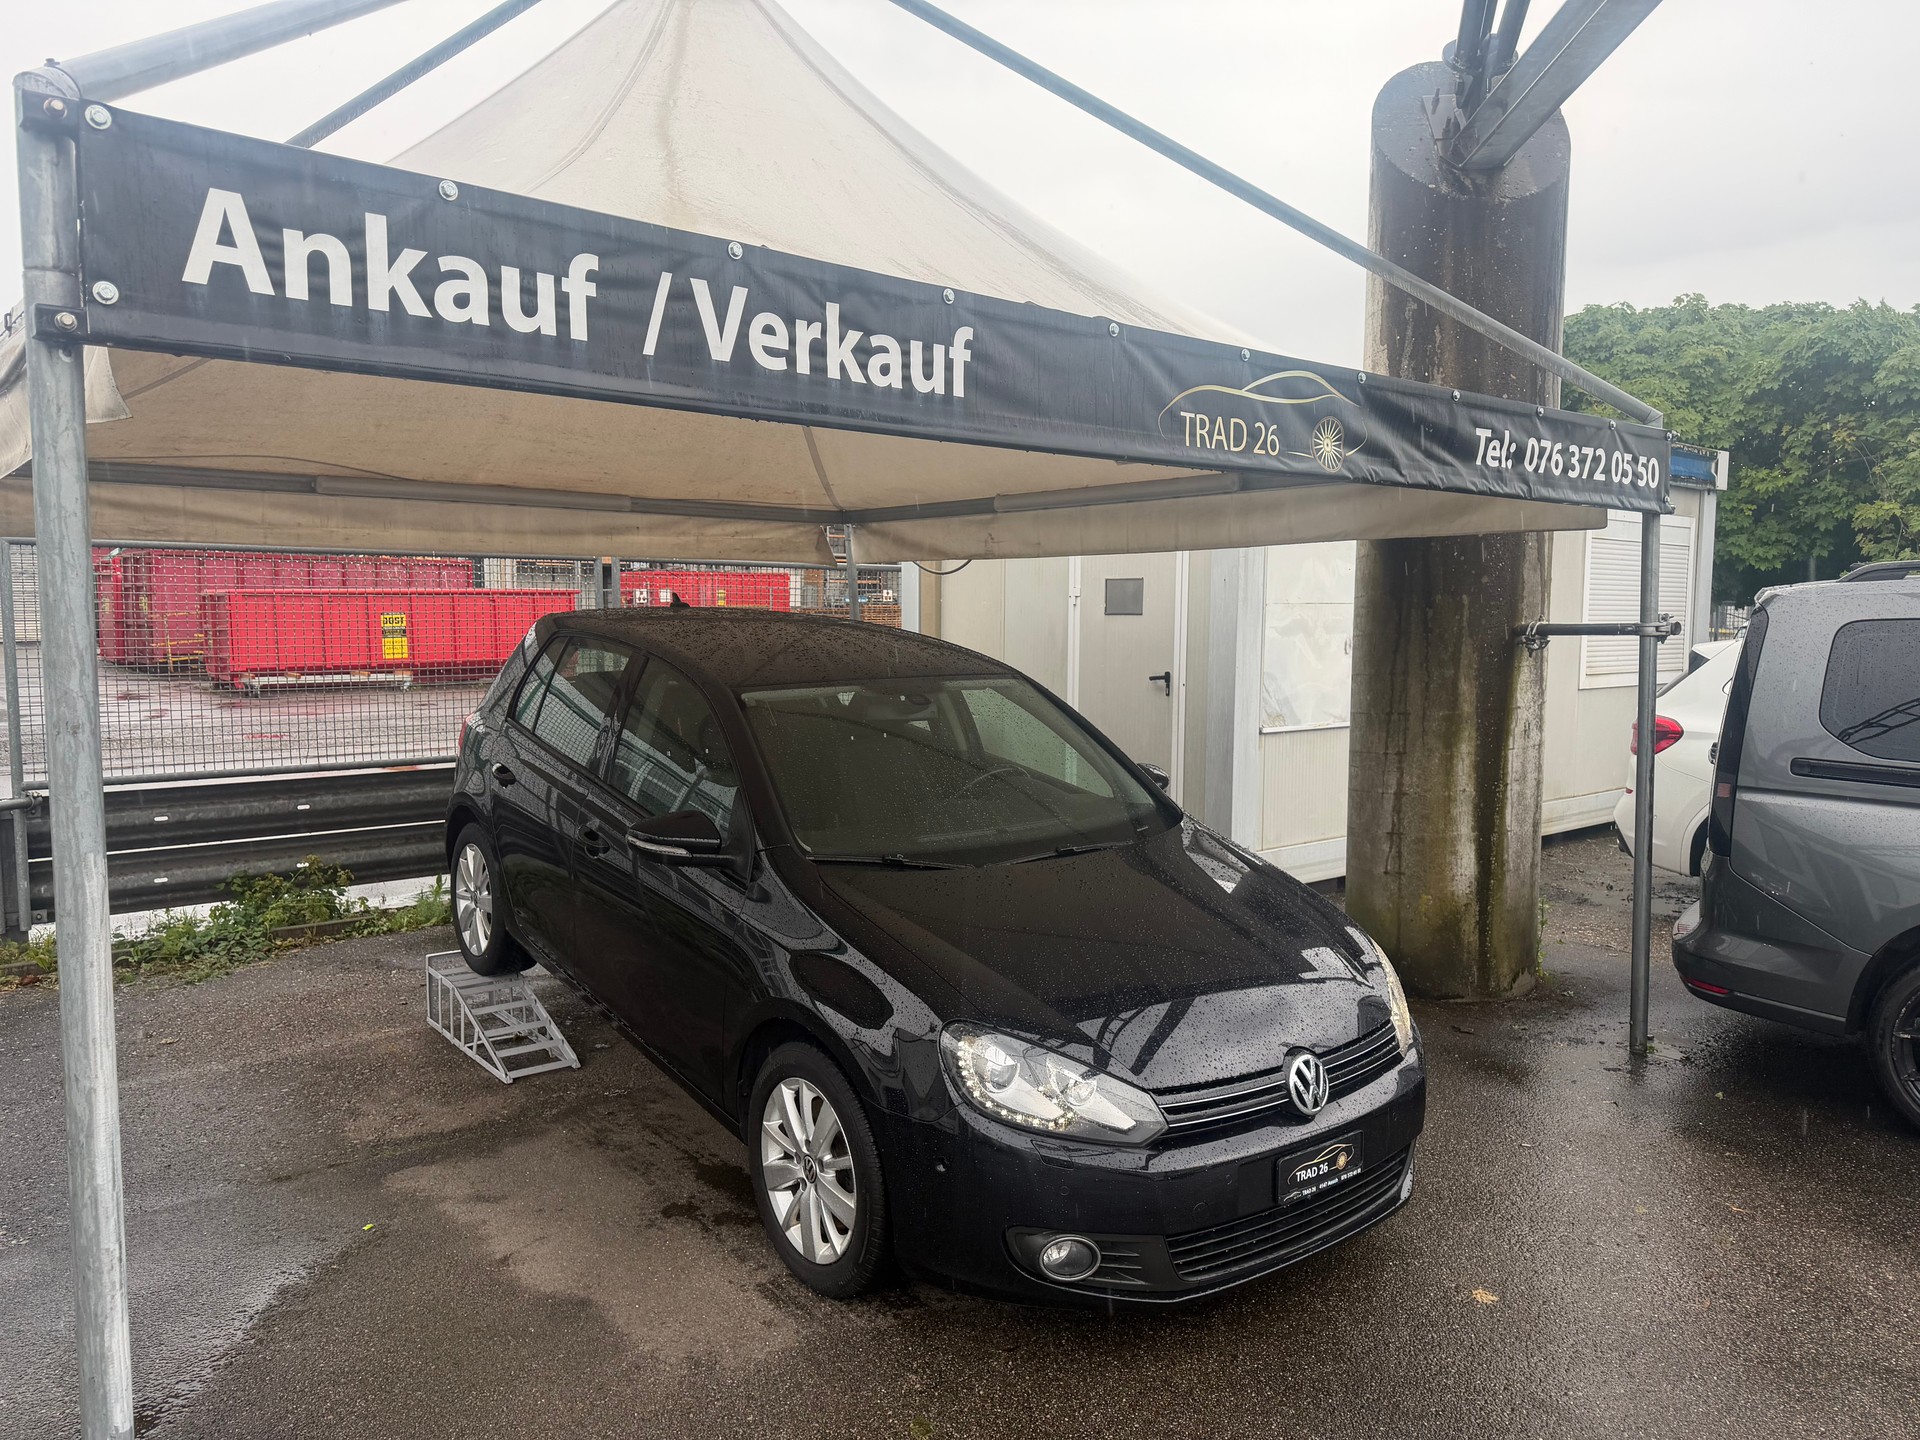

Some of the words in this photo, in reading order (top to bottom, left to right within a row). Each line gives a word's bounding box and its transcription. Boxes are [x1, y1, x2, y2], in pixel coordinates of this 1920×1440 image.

[182, 188, 599, 342] Ankauf
[643, 272, 672, 356] /
[690, 278, 975, 398] Verkauf
[1180, 411, 1248, 452] TRAD
[1253, 422, 1281, 457] 26
[1475, 428, 1517, 470] Tel:
[1524, 437, 1564, 476] 076
[1568, 445, 1607, 481] 372
[1611, 451, 1633, 486] 05
[1637, 456, 1660, 489] 50
[1290, 1054, 1329, 1115] VW
[1296, 1167, 1318, 1182] TRAD
[1319, 1162, 1329, 1175] 26
